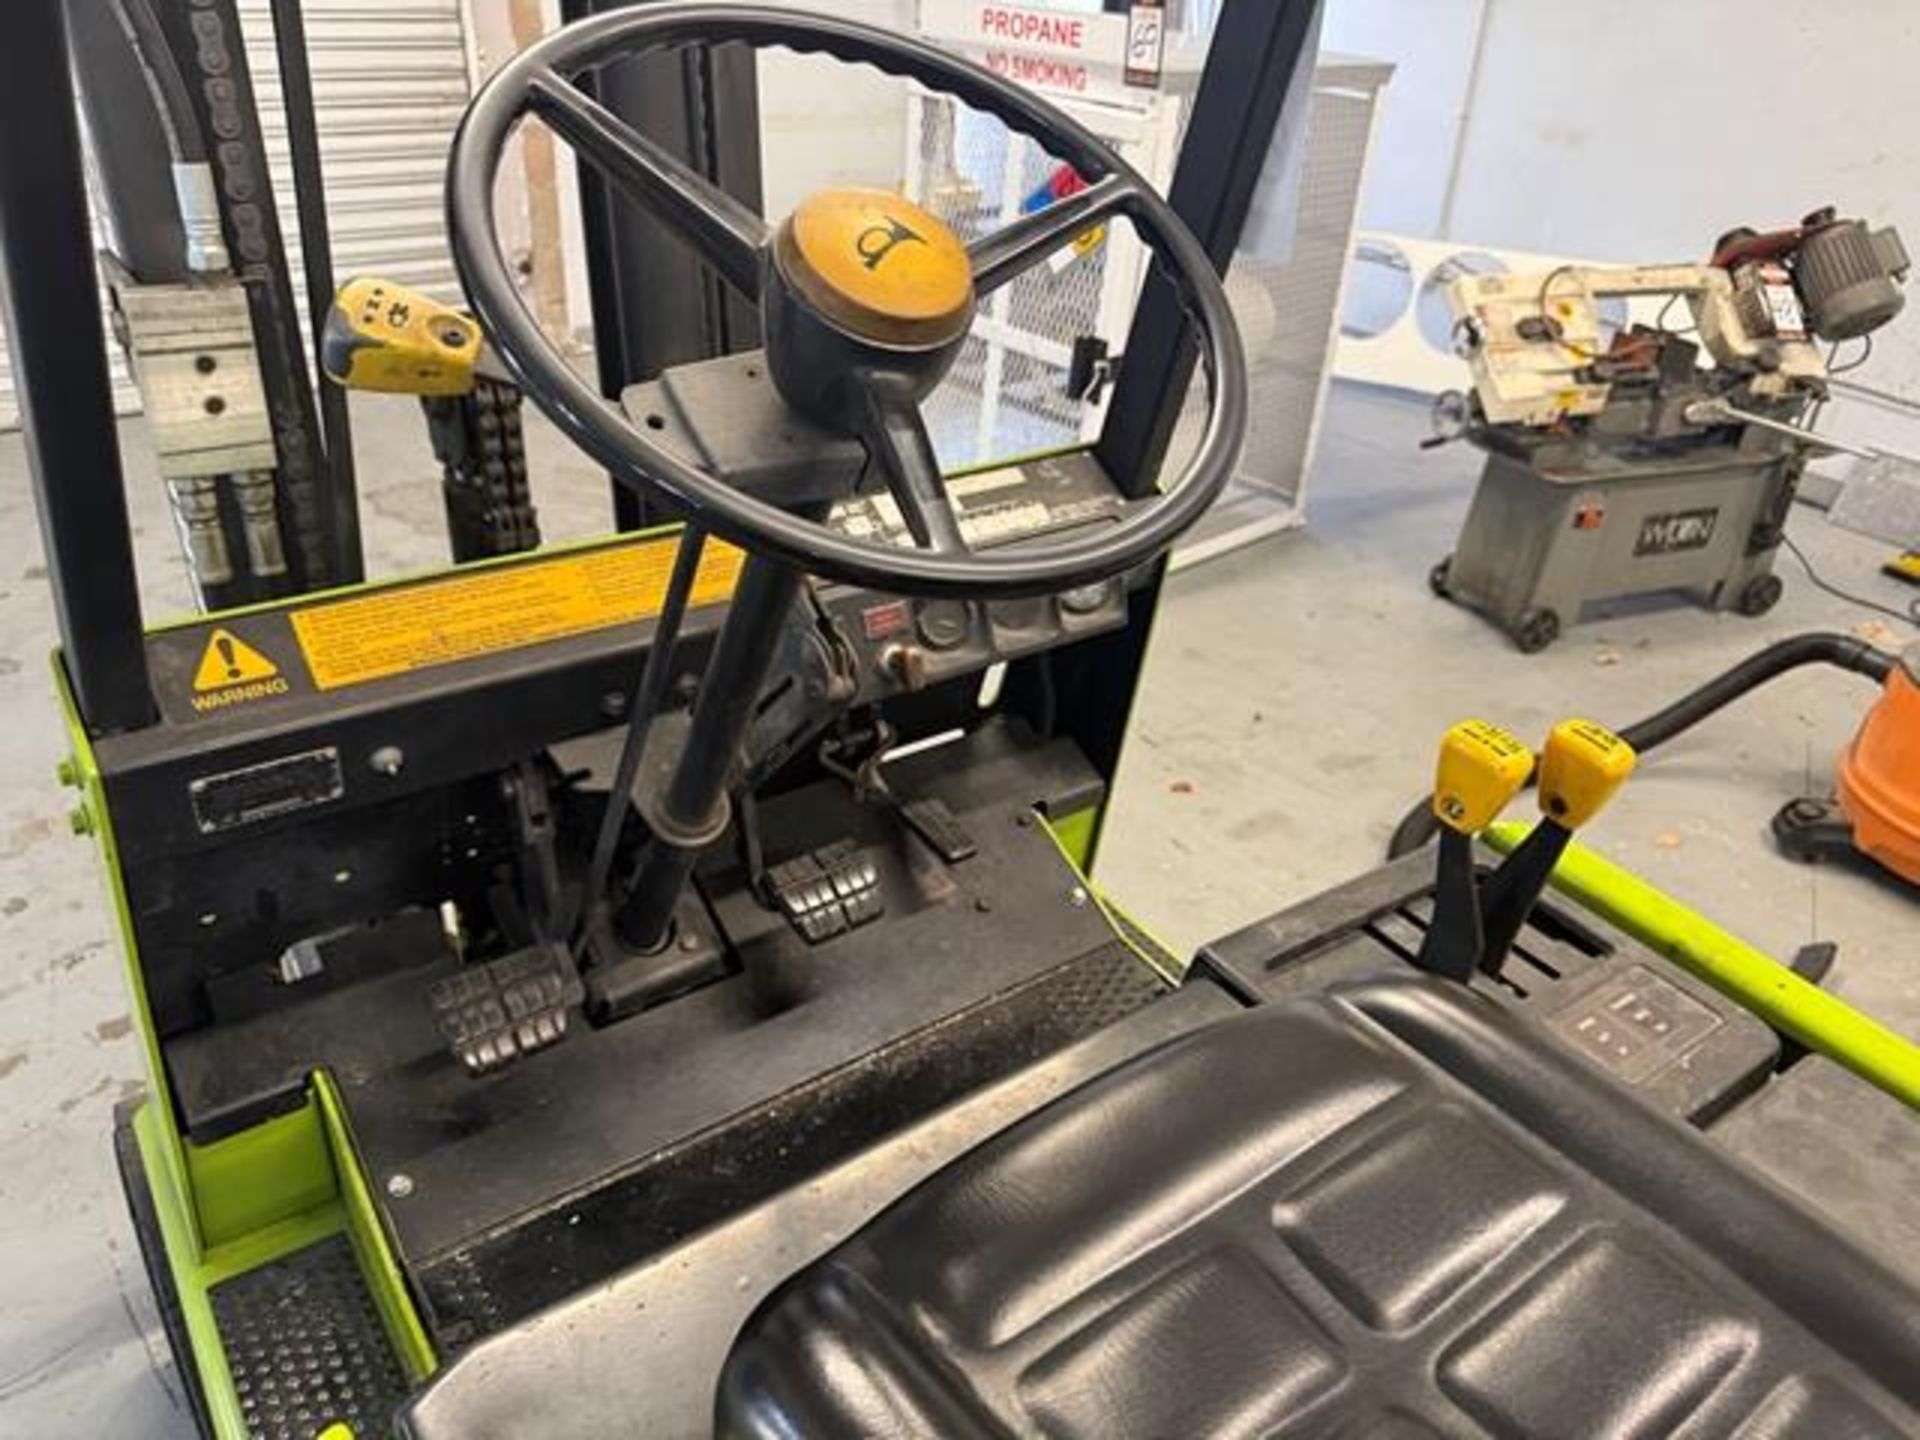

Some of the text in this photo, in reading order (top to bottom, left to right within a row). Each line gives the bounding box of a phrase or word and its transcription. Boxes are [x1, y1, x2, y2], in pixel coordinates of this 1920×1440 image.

[982, 8, 1083, 49] PROPANE
[986, 51, 1086, 92] NO SMOKING
[191, 677, 289, 712] WARNING
